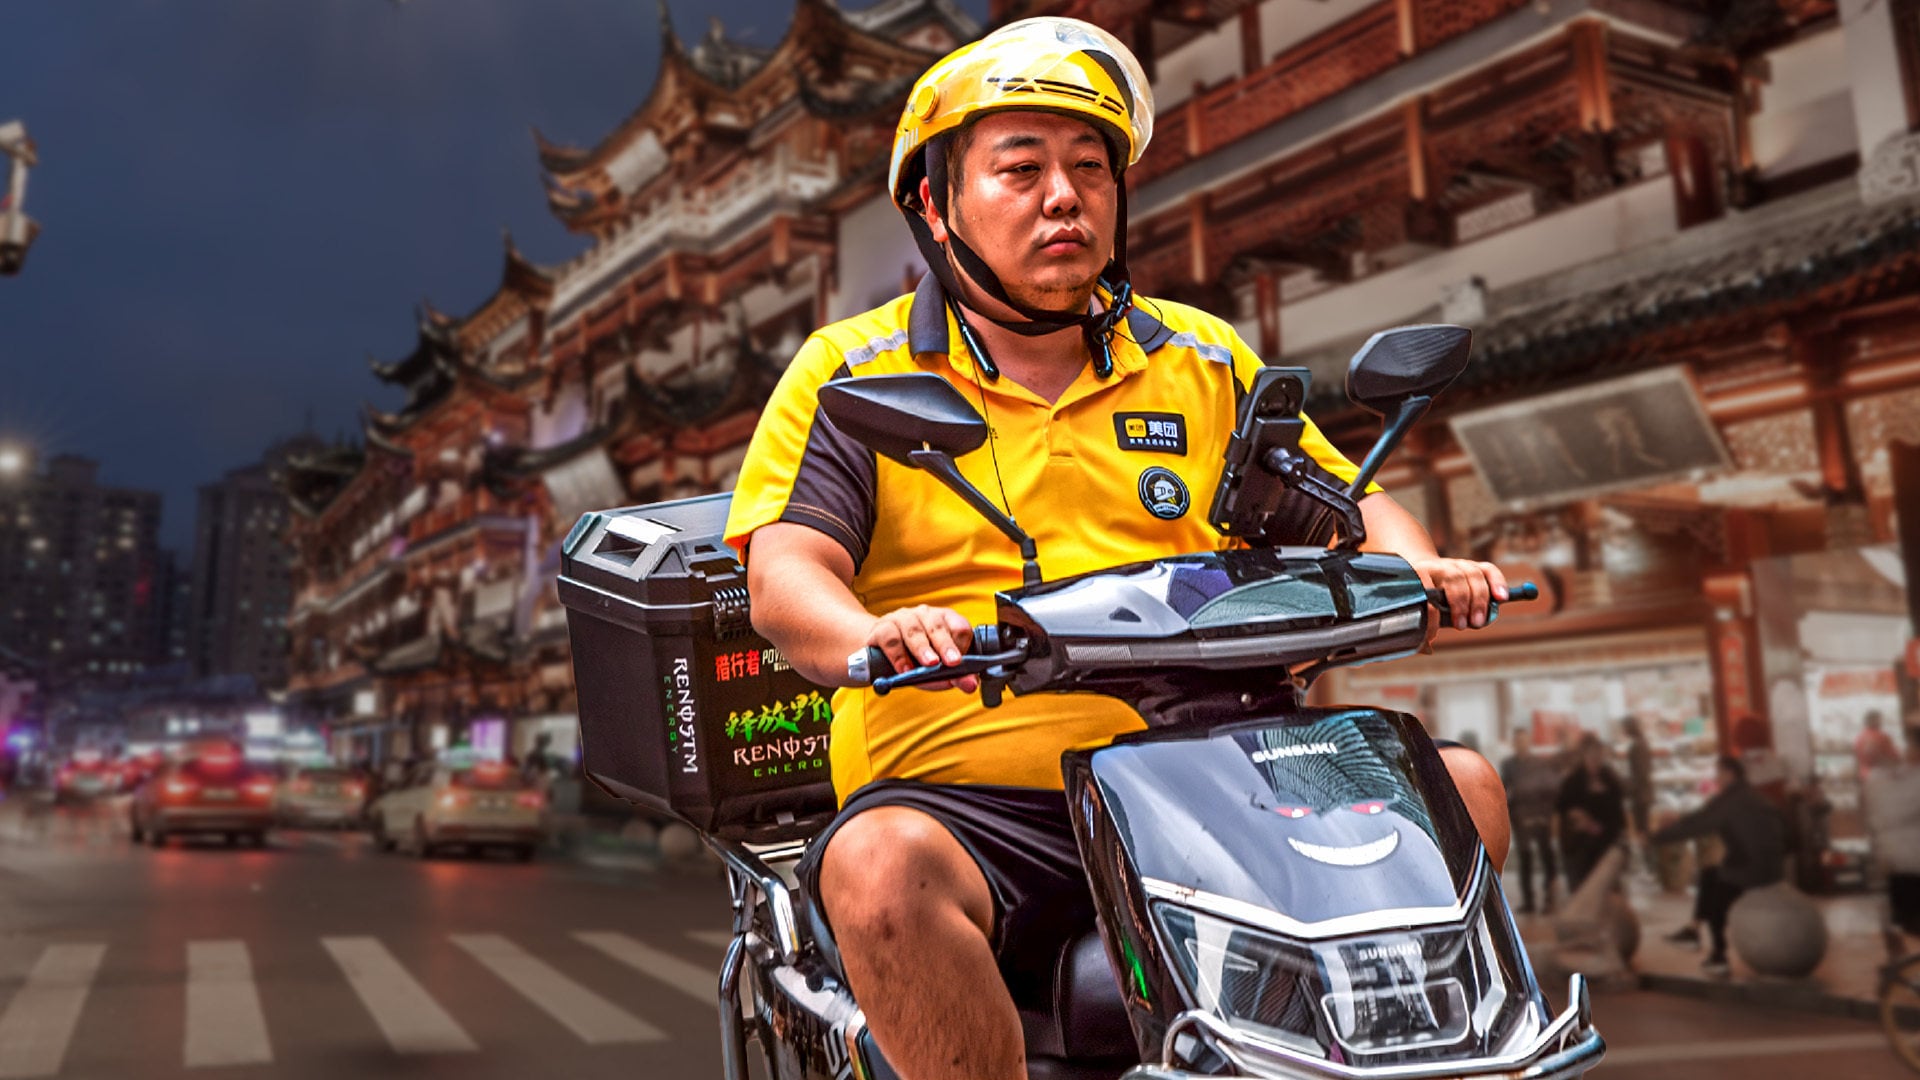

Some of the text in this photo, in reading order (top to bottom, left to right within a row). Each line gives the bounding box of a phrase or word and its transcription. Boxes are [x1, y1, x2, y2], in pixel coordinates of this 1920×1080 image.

[1147, 420, 1178, 438] 美团
[715, 649, 760, 682] 猎行者
[724, 689, 832, 743] 释放野
[753, 758, 823, 778] ENERG
